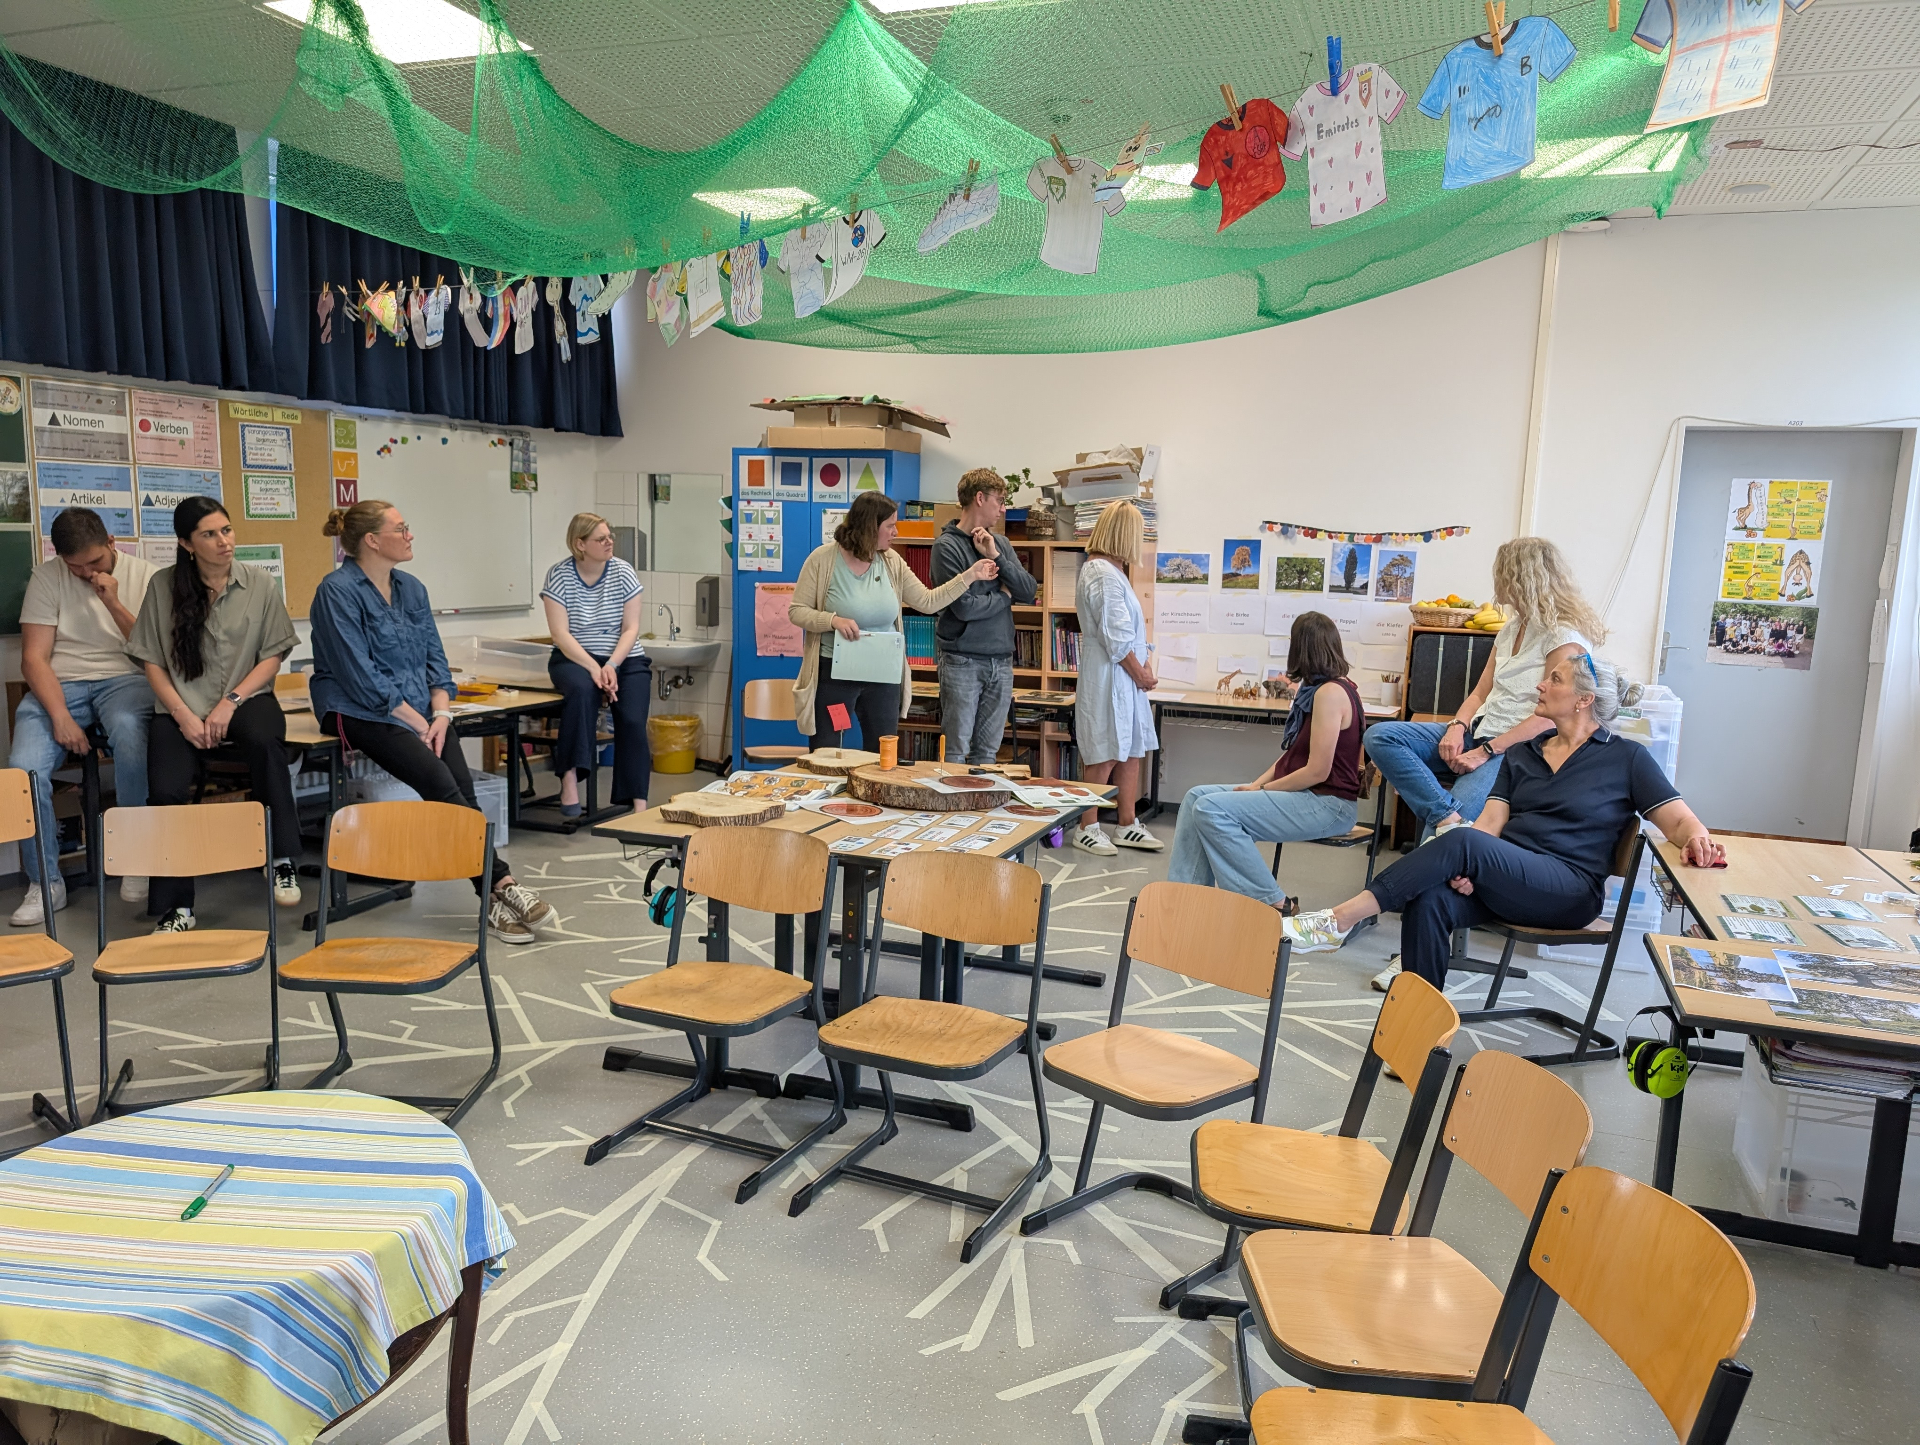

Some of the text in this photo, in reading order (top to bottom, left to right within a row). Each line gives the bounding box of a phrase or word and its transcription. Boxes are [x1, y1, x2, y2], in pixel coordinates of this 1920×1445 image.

[1520, 55, 1533, 77] B
[1316, 117, 1360, 141] Emirates
[63, 413, 105, 429] Nomen
[233, 405, 299, 421] Wörtliche Rede
[153, 420, 189, 435] Verben
[70, 492, 107, 506] Artikel
[340, 483, 355, 503] M
[1670, 1063, 1685, 1073] kid
